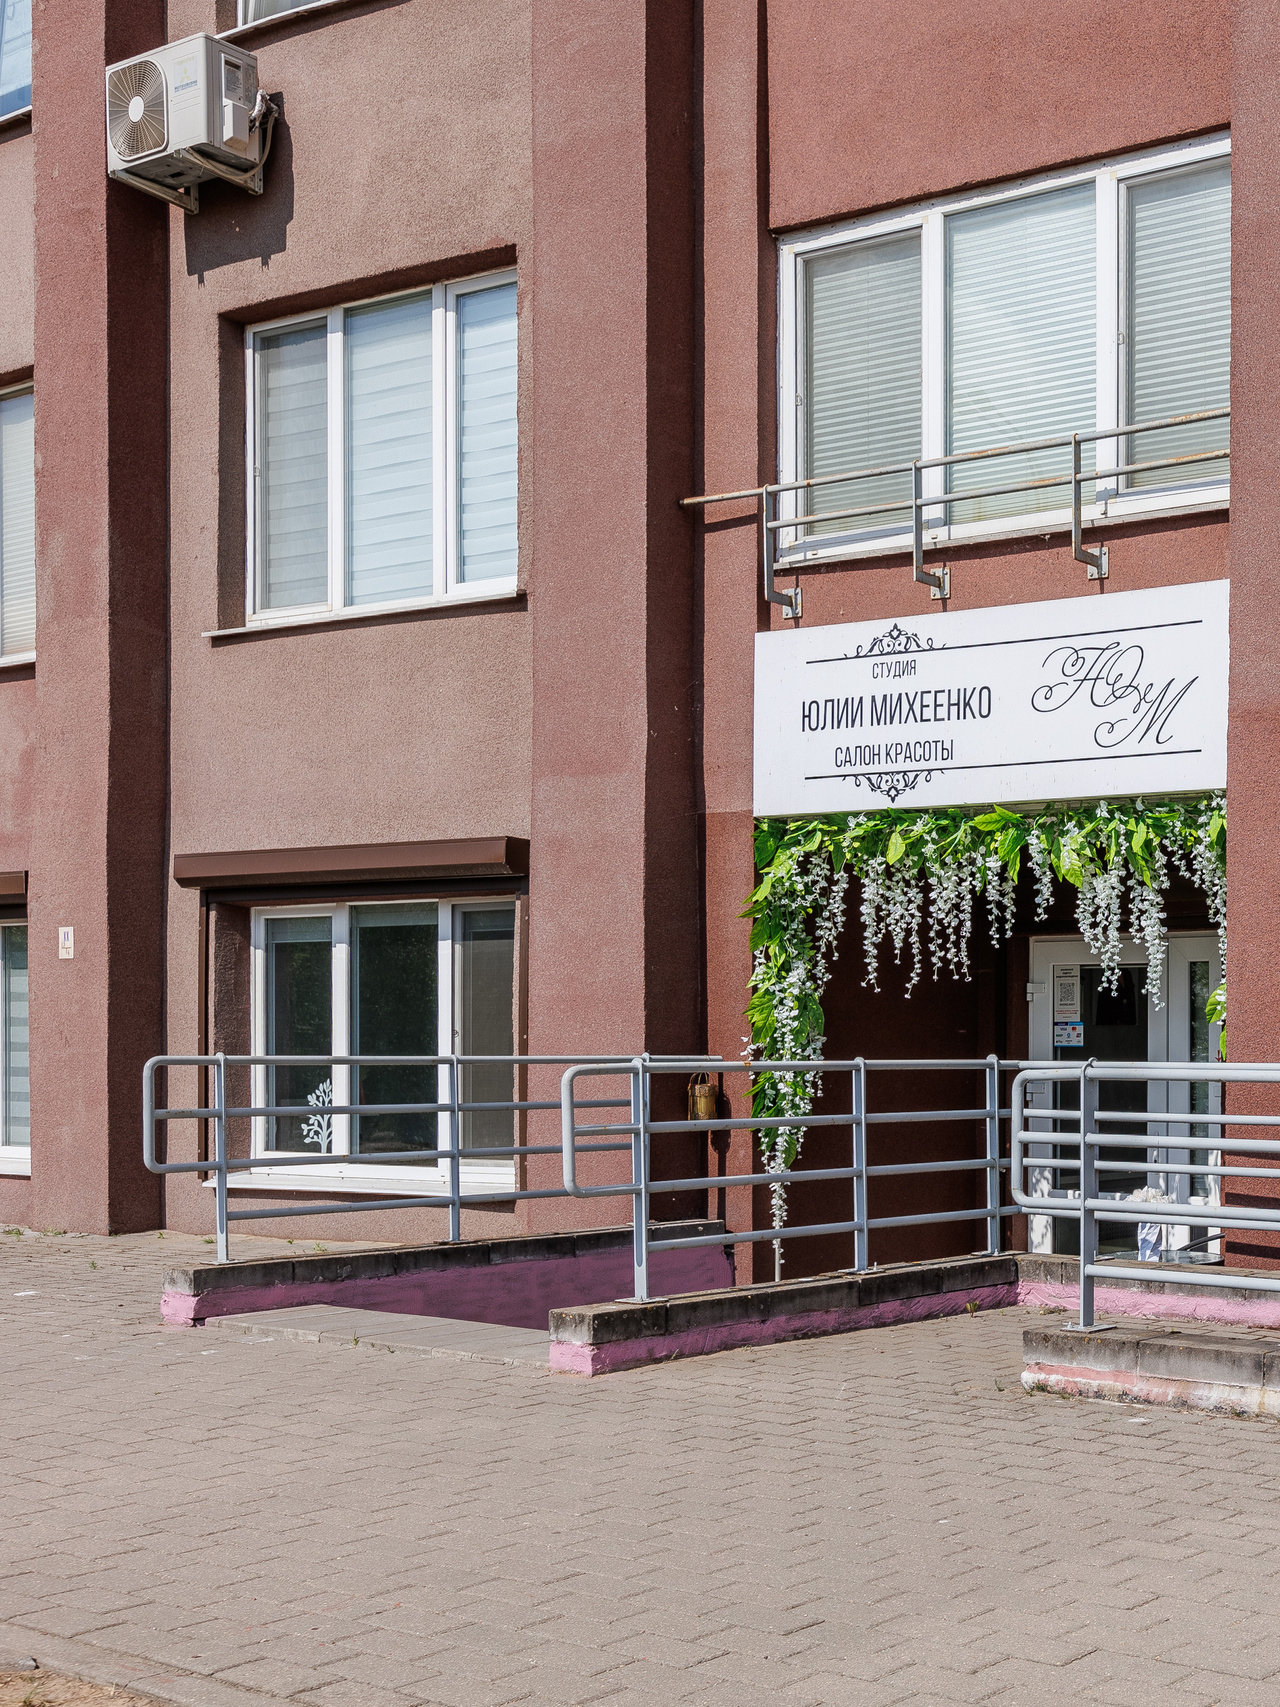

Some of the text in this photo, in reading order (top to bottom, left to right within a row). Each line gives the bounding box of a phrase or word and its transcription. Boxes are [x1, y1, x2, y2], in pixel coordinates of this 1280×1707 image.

[872, 660, 917, 680] СТУДИЯ
[801, 685, 992, 733] ЮЛИИ МИХЕЕНКО
[834, 739, 954, 768] САЛОН КРАСОТЫ
